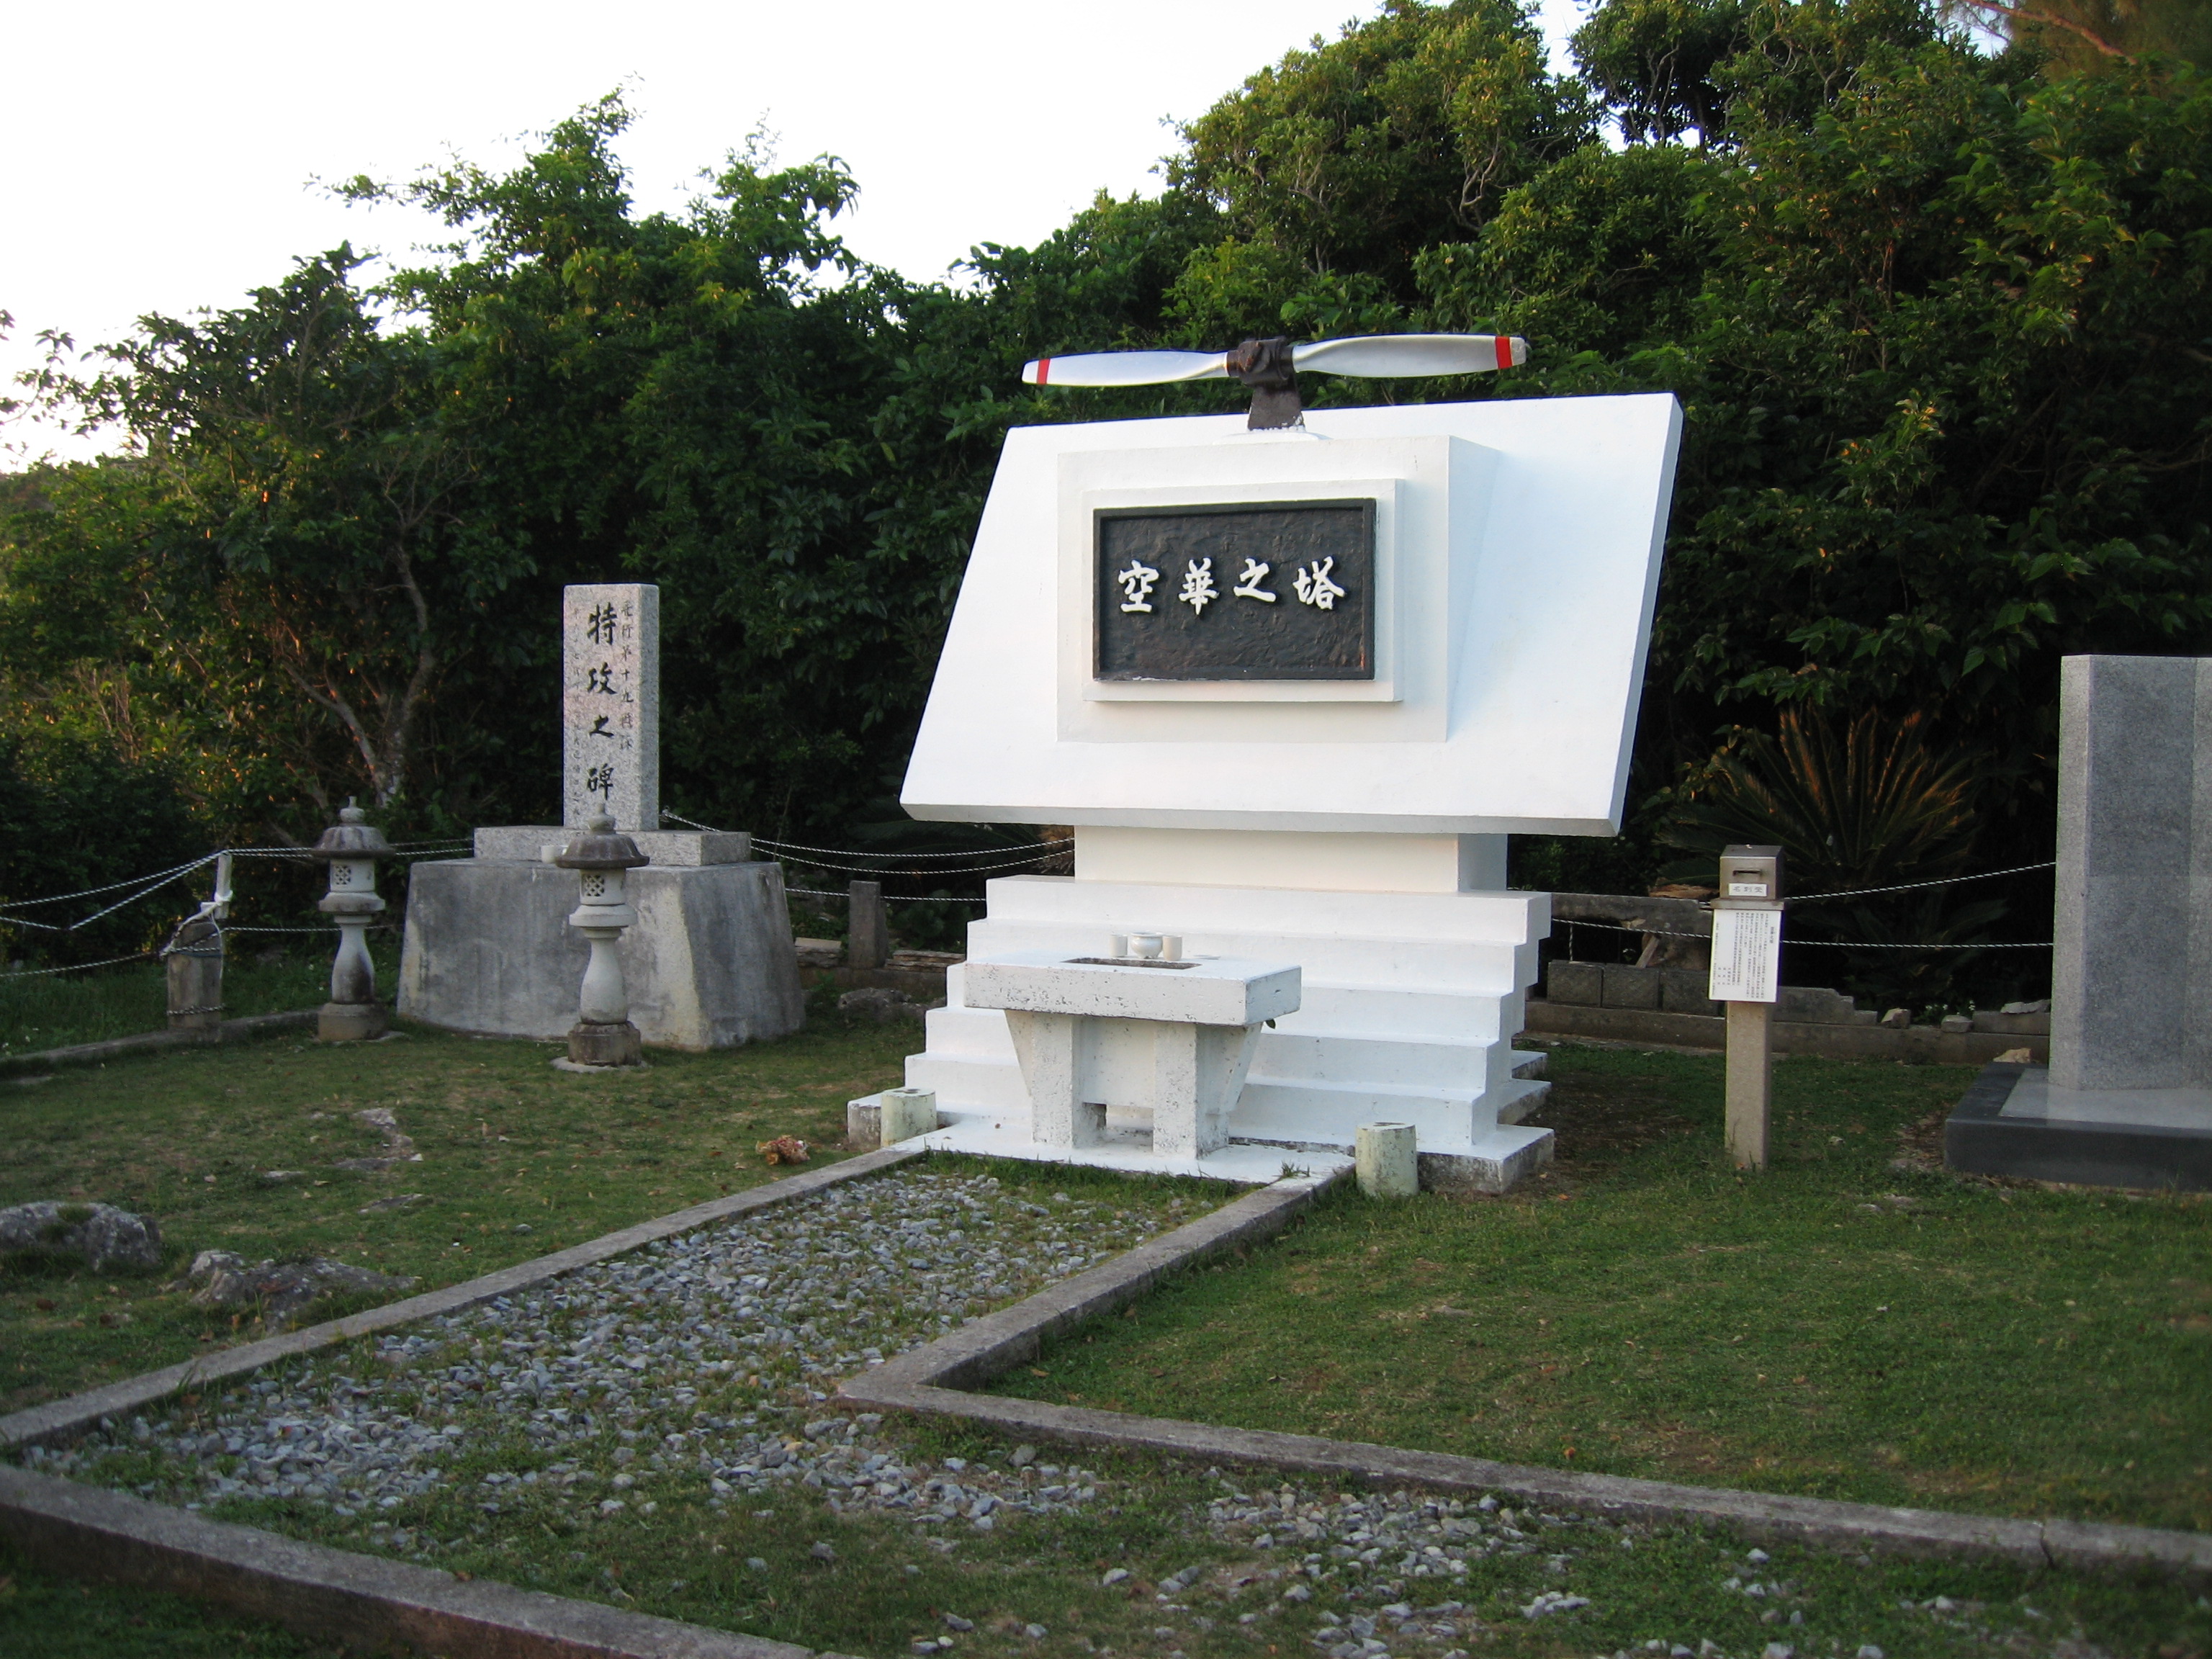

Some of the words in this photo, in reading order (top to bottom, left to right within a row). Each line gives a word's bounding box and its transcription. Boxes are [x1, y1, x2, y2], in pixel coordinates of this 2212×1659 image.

[1118, 555, 1346, 615] 空華之塔
[586, 601, 618, 801] 特攻之碑
